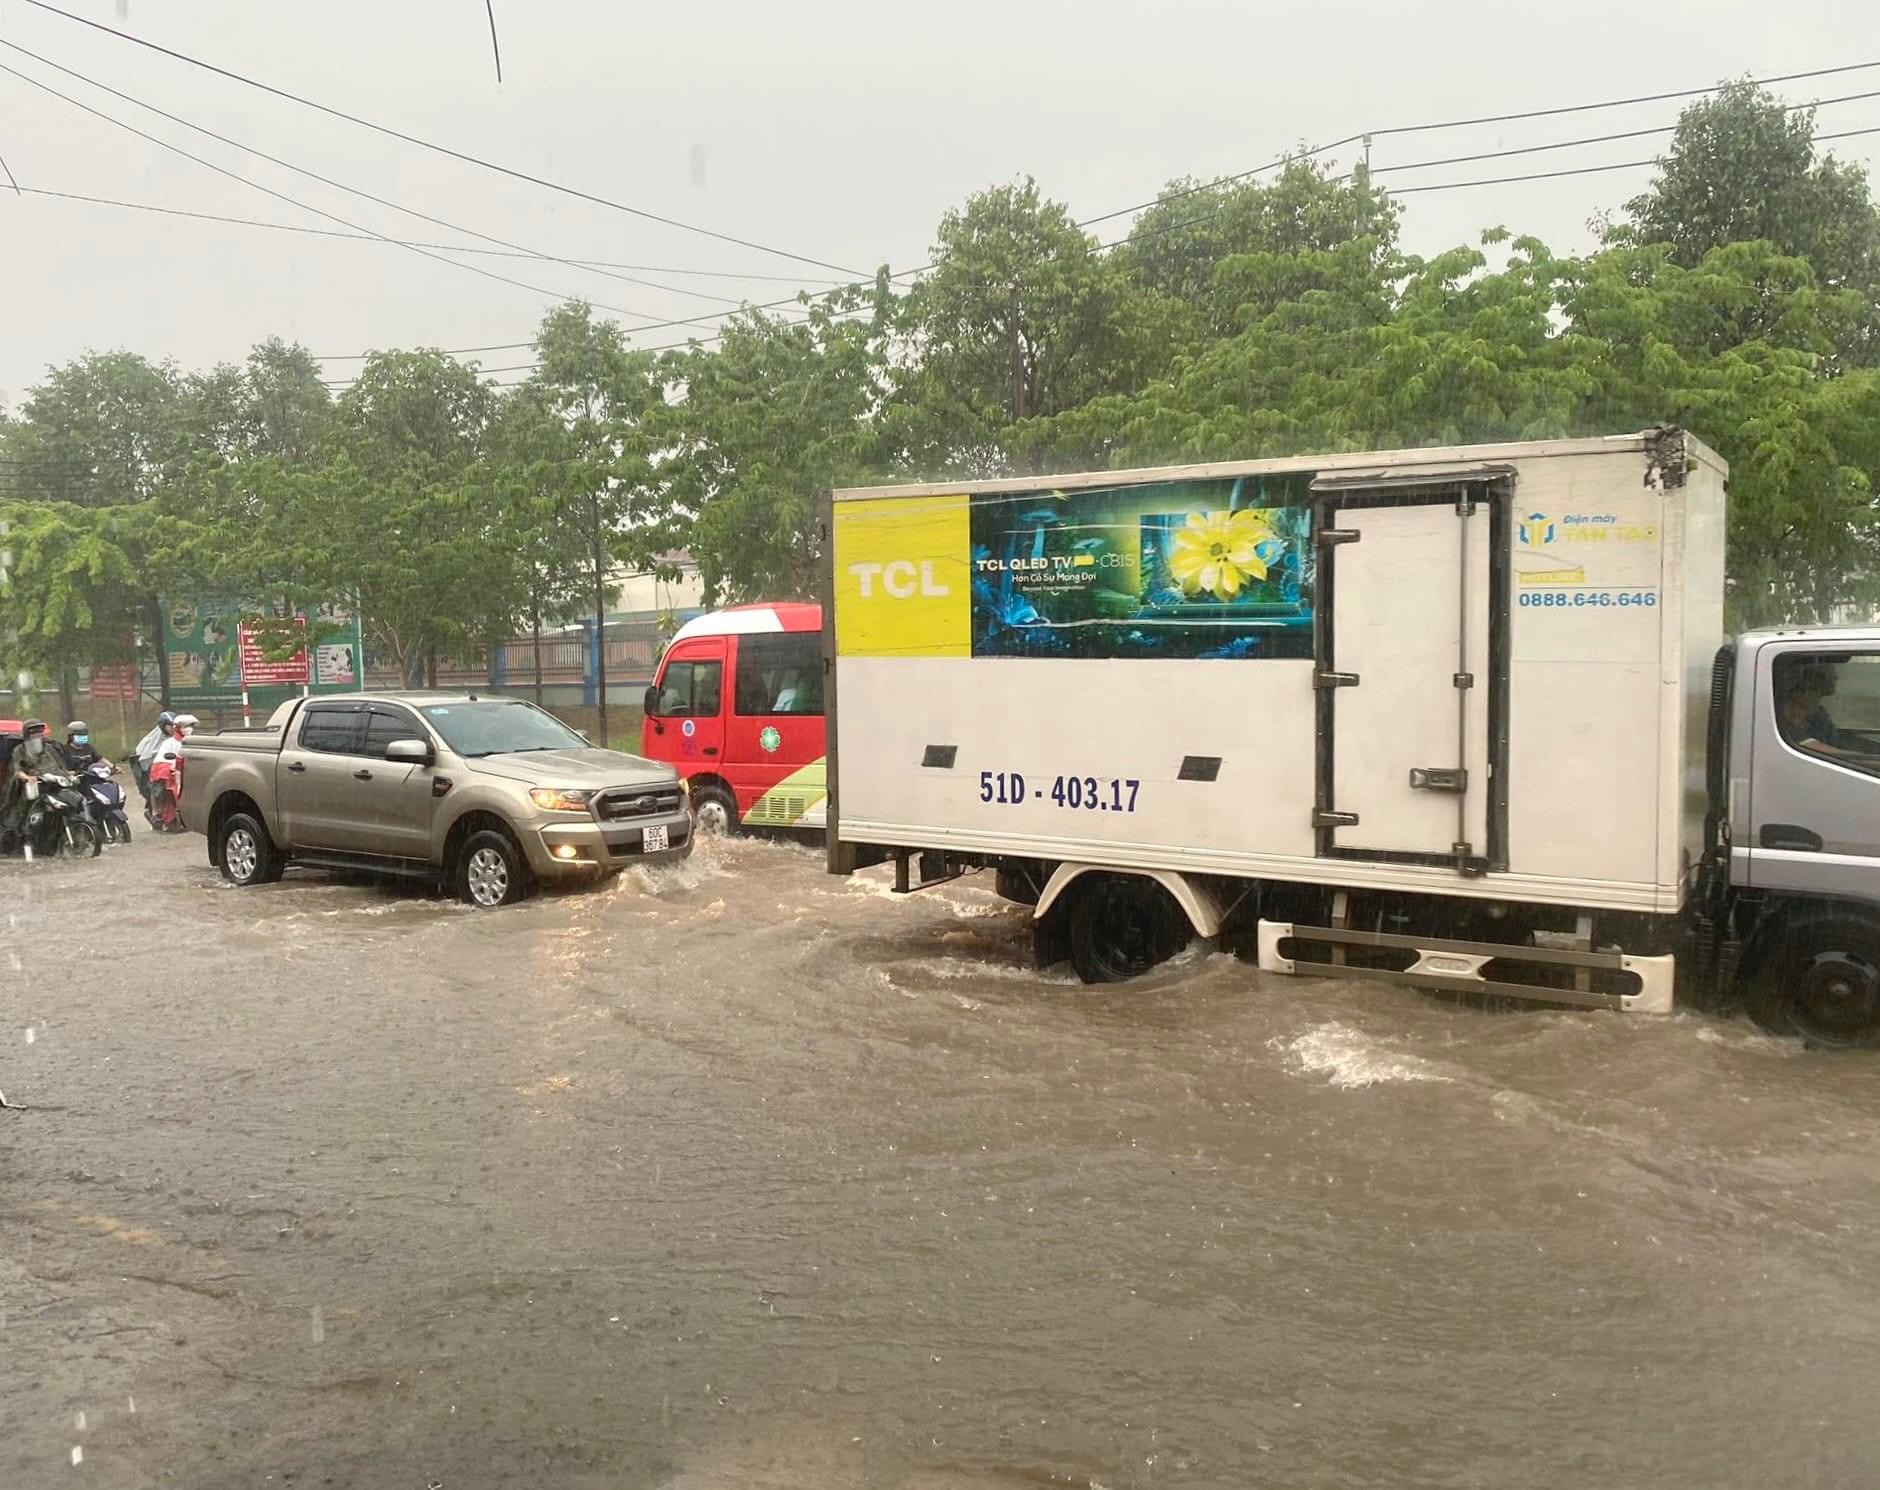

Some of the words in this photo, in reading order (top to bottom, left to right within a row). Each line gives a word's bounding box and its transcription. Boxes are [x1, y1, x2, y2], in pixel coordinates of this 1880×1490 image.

[976, 560, 1007, 572] TCL
[1010, 557, 1048, 570] QLED
[1051, 556, 1072, 569] TV
[848, 560, 950, 599] TCL
[1519, 592, 1656, 607] 0888.646.646
[980, 771, 1026, 805] 51D
[1051, 775, 1140, 812] 403.17
